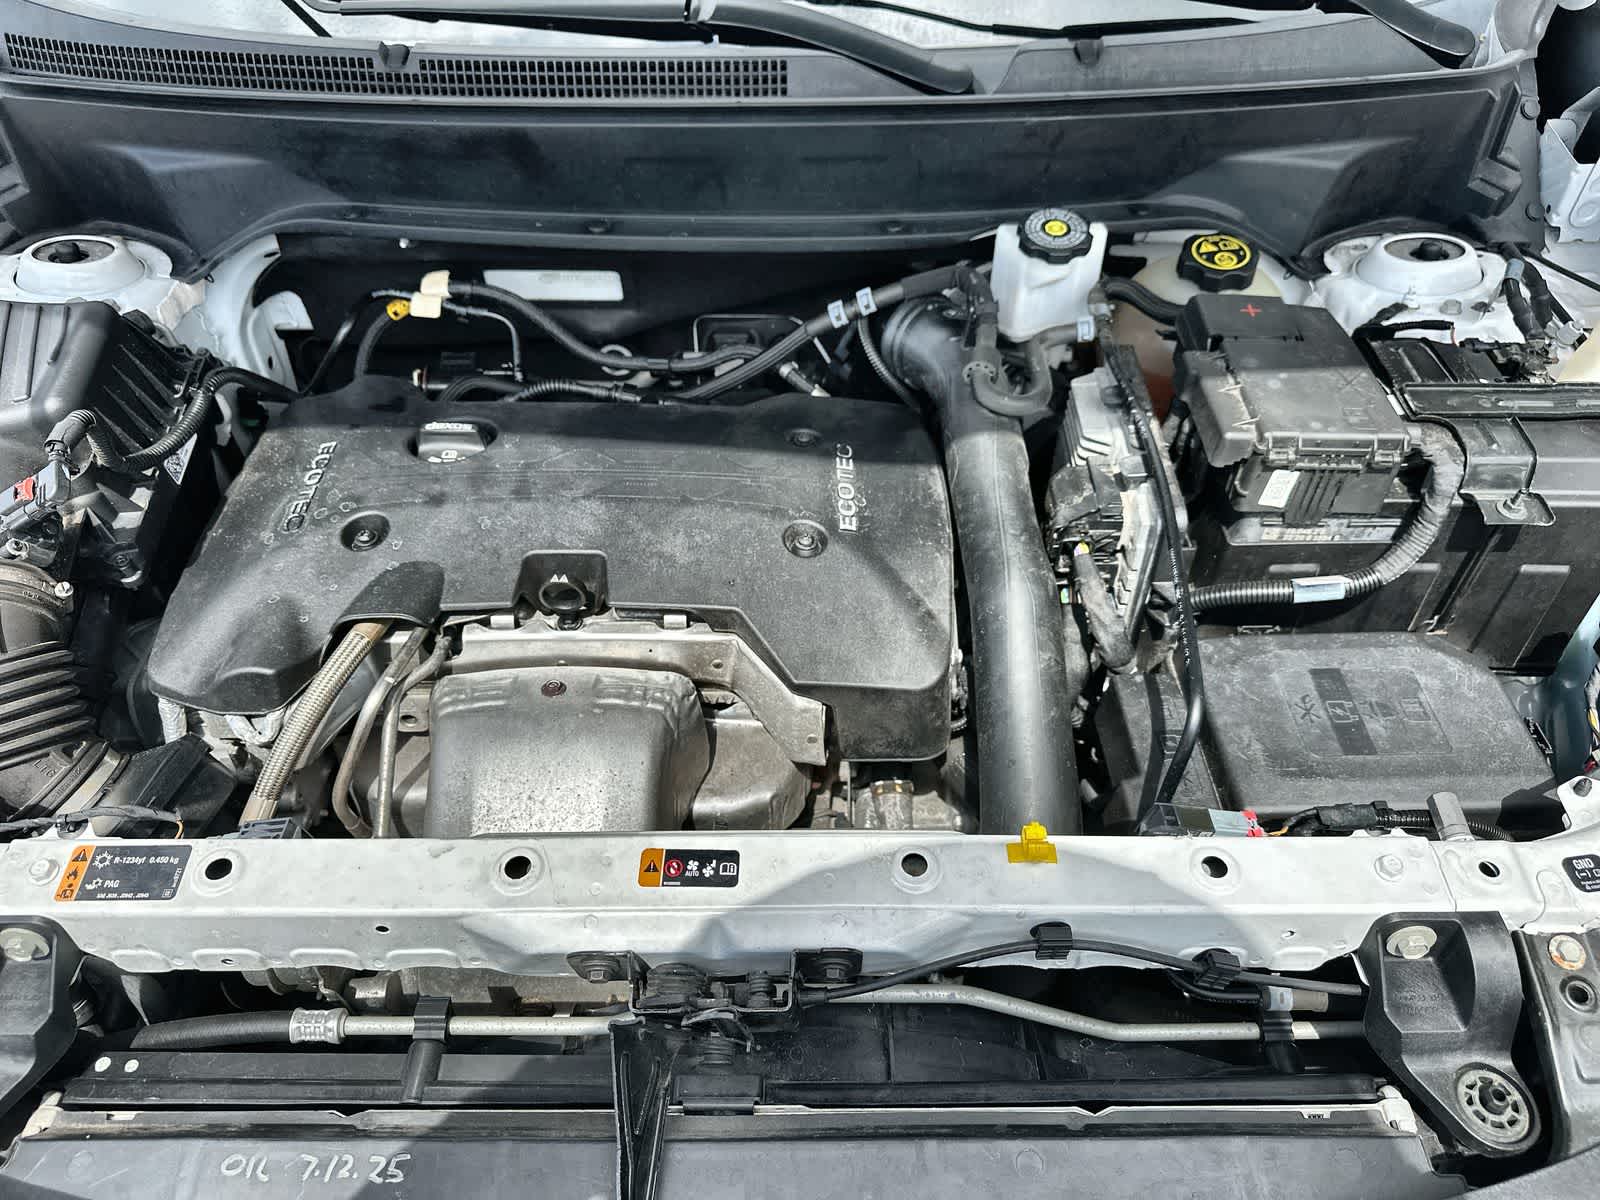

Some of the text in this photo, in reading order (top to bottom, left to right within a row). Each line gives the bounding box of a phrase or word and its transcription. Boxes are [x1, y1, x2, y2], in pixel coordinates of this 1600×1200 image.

[281, 441, 337, 533] ECOTEC
[836, 444, 857, 532] ECOTEC
[113, 856, 180, 865] R-1234yf 0.450 kg
[1572, 858, 1595, 870] GND
[103, 879, 120, 888] PAG
